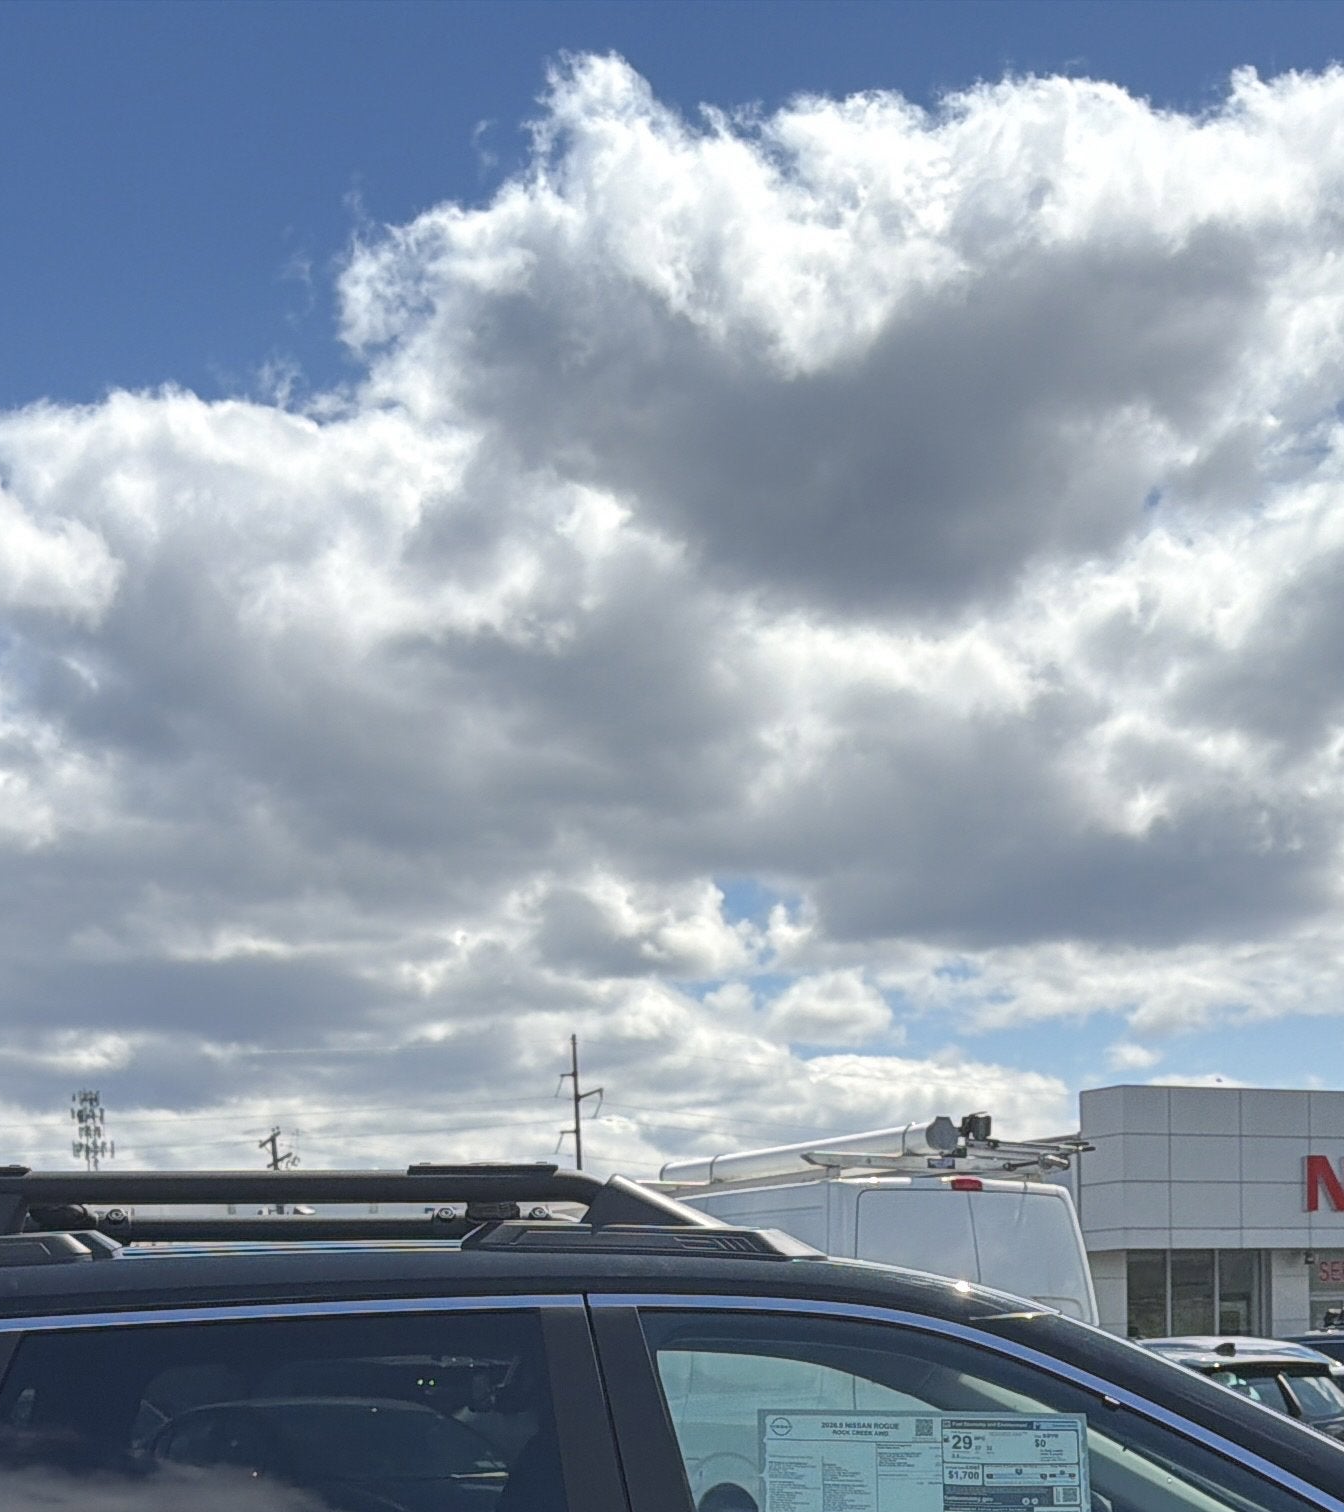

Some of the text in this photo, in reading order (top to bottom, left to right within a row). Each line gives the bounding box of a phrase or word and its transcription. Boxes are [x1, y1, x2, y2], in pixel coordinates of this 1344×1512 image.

[951, 1434, 973, 1450] 29
[1035, 1439, 1046, 1448] $0
[948, 1470, 980, 1481] $1,700
